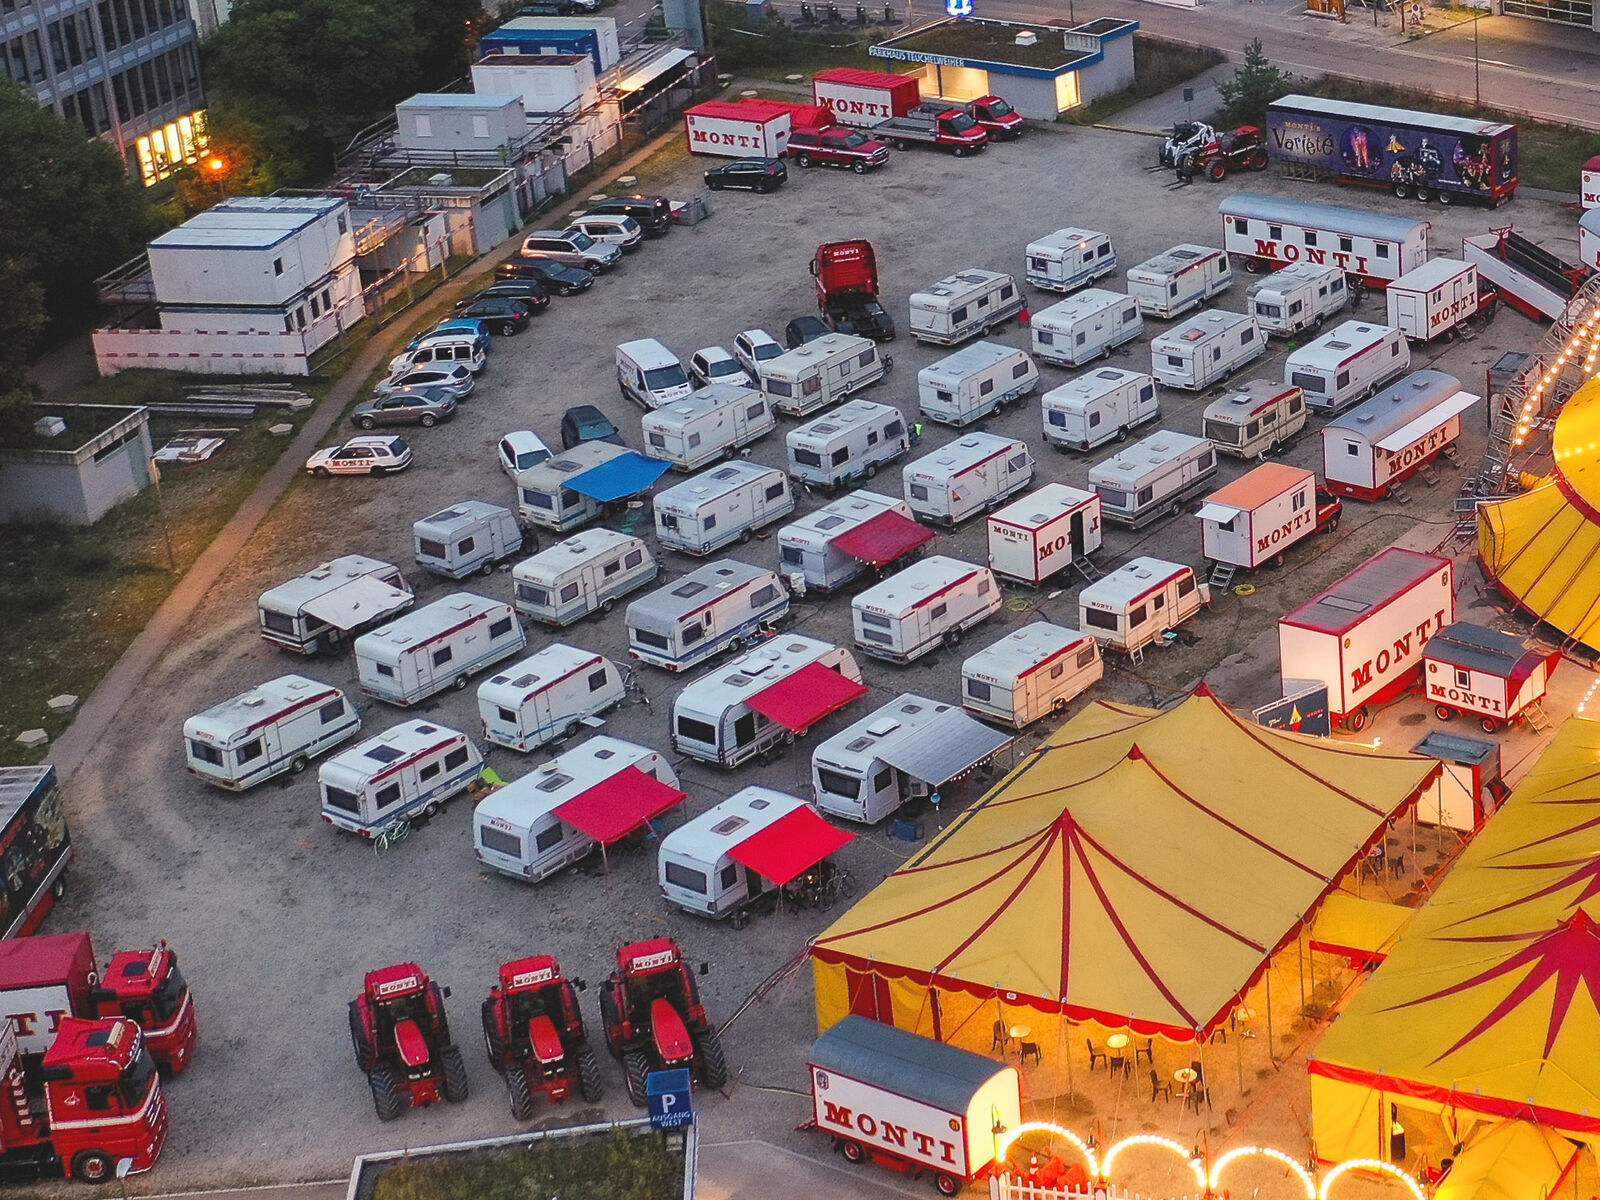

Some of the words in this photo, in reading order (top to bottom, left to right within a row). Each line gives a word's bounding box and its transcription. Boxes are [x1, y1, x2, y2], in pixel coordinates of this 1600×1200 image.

[869, 48, 906, 60] PARKHAUS
[908, 53, 965, 67] TEUCHELWEIHER
[819, 96, 890, 118] MONTI
[692, 130, 761, 149] MONTI
[1254, 239, 1368, 274] MONTI
[1430, 291, 1475, 328] MONTI
[661, 391, 689, 399] MONTI
[1388, 427, 1448, 477] MONTI
[332, 459, 371, 467] MONTI
[993, 525, 1029, 541] MONTI
[1039, 516, 1099, 561] MOI
[1257, 508, 1312, 554] MONTI
[524, 575, 543, 584] MONTI
[866, 605, 886, 613] MONTI
[1092, 602, 1112, 610] MONTI
[1351, 609, 1445, 694] MONTI
[977, 673, 998, 683] MONTI
[1430, 683, 1502, 712] MONTI
[491, 820, 511, 831] MONTI
[635, 955, 672, 969] MONTI
[382, 981, 416, 993] MONTI
[516, 972, 552, 986] MONTI
[662, 1094, 676, 1113] P
[652, 1111, 691, 1123] AUSGANG
[660, 1119, 682, 1127] WEST
[823, 1100, 956, 1165] MONTI
